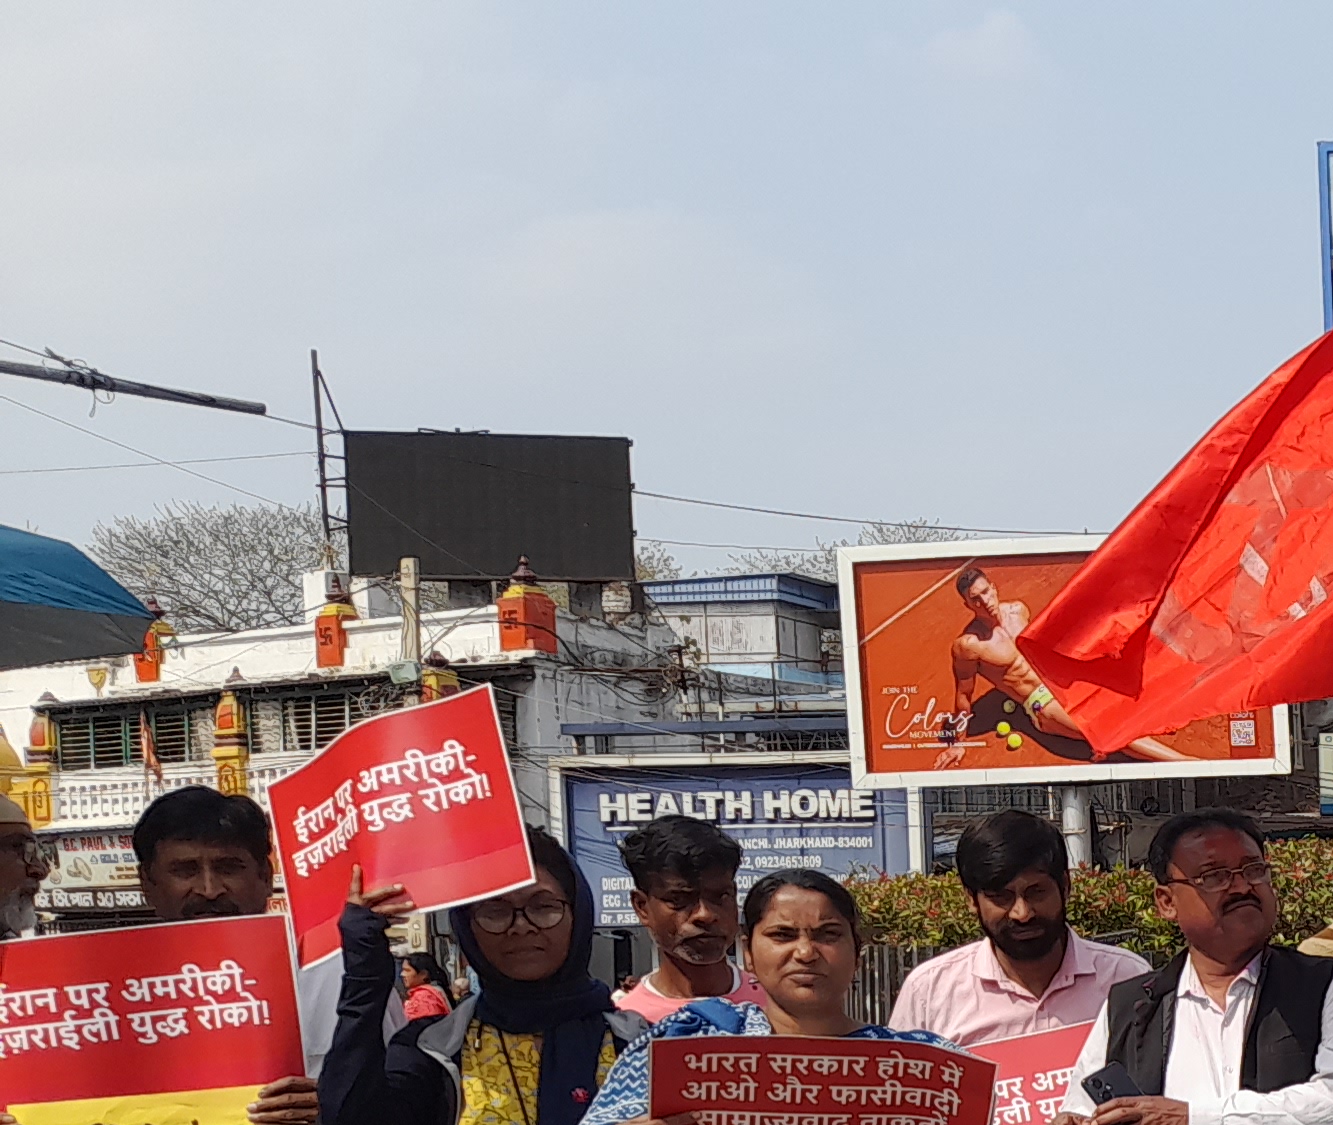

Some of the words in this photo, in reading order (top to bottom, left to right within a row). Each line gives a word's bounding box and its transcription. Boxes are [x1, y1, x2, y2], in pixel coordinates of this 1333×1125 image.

[885, 694, 974, 738] Colors
[292, 805, 335, 844] ईरान
[335, 779, 354, 808] पर
[357, 739, 478, 793] अमरीकी-
[360, 792, 415, 832] युद्ध
[418, 768, 493, 812] रोको!
[600, 790, 752, 822] HEALTH
[763, 787, 875, 819] HOME
[683, 1052, 761, 1075] भारत
[767, 1053, 869, 1077] सरकार
[875, 1049, 934, 1083] होश
[939, 1064, 964, 1089] में
[681, 1074, 758, 1102] आओ
[767, 1077, 819, 1105] और
[829, 1080, 961, 1117] फासीवादी
